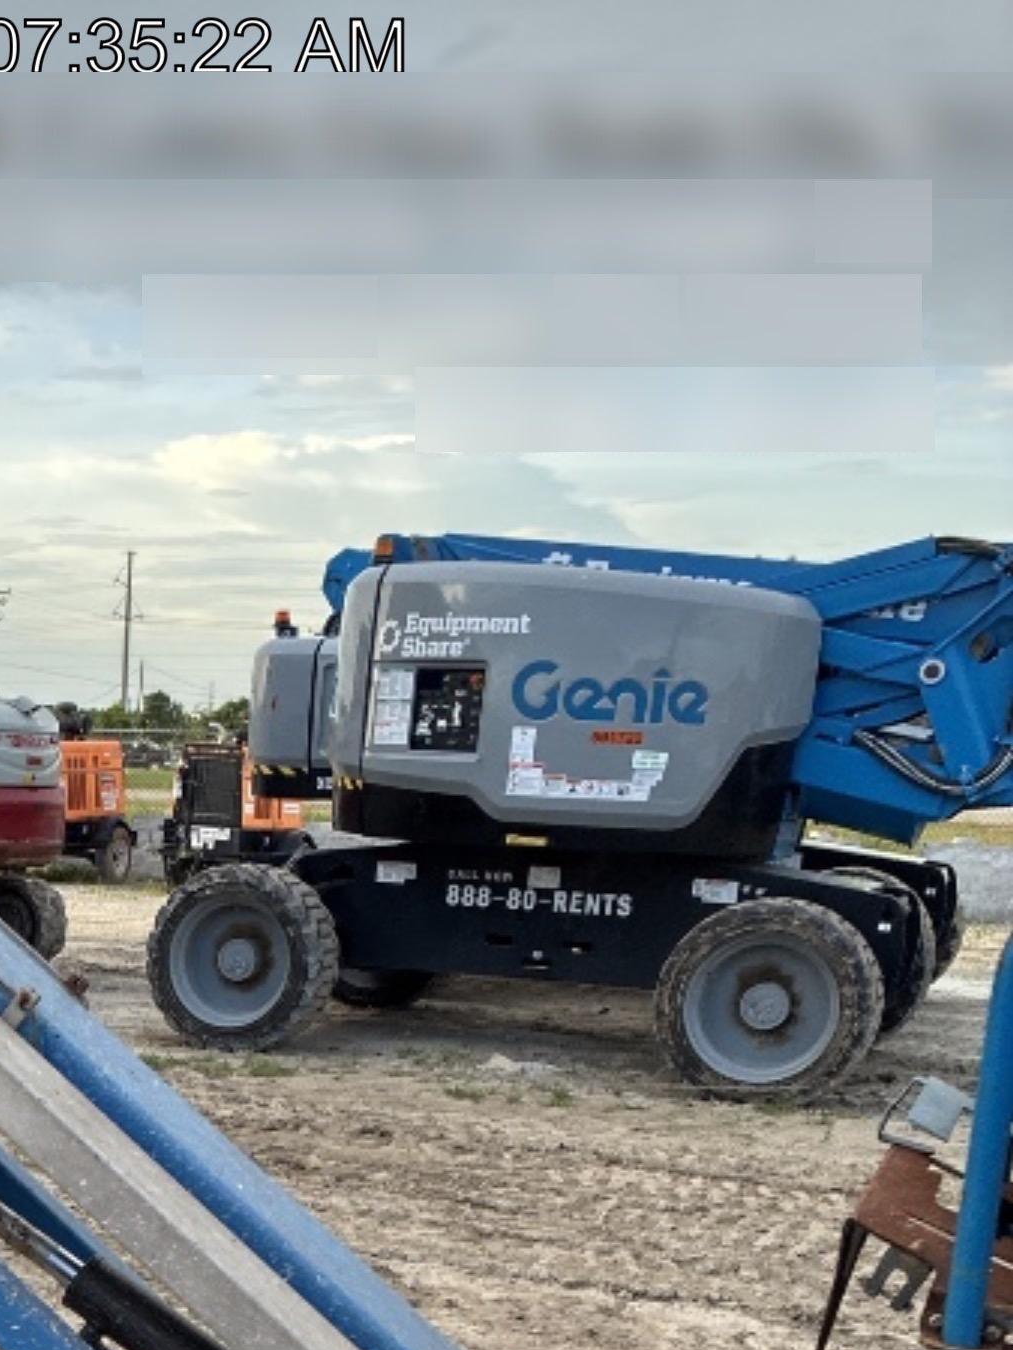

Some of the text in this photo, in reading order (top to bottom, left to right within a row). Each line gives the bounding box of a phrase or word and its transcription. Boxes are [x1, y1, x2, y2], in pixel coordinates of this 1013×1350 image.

[403, 612, 532, 637] Equipment
[400, 638, 464, 658] Share
[511, 658, 709, 725] Genie
[445, 884, 634, 918] 888-80-RENTS
